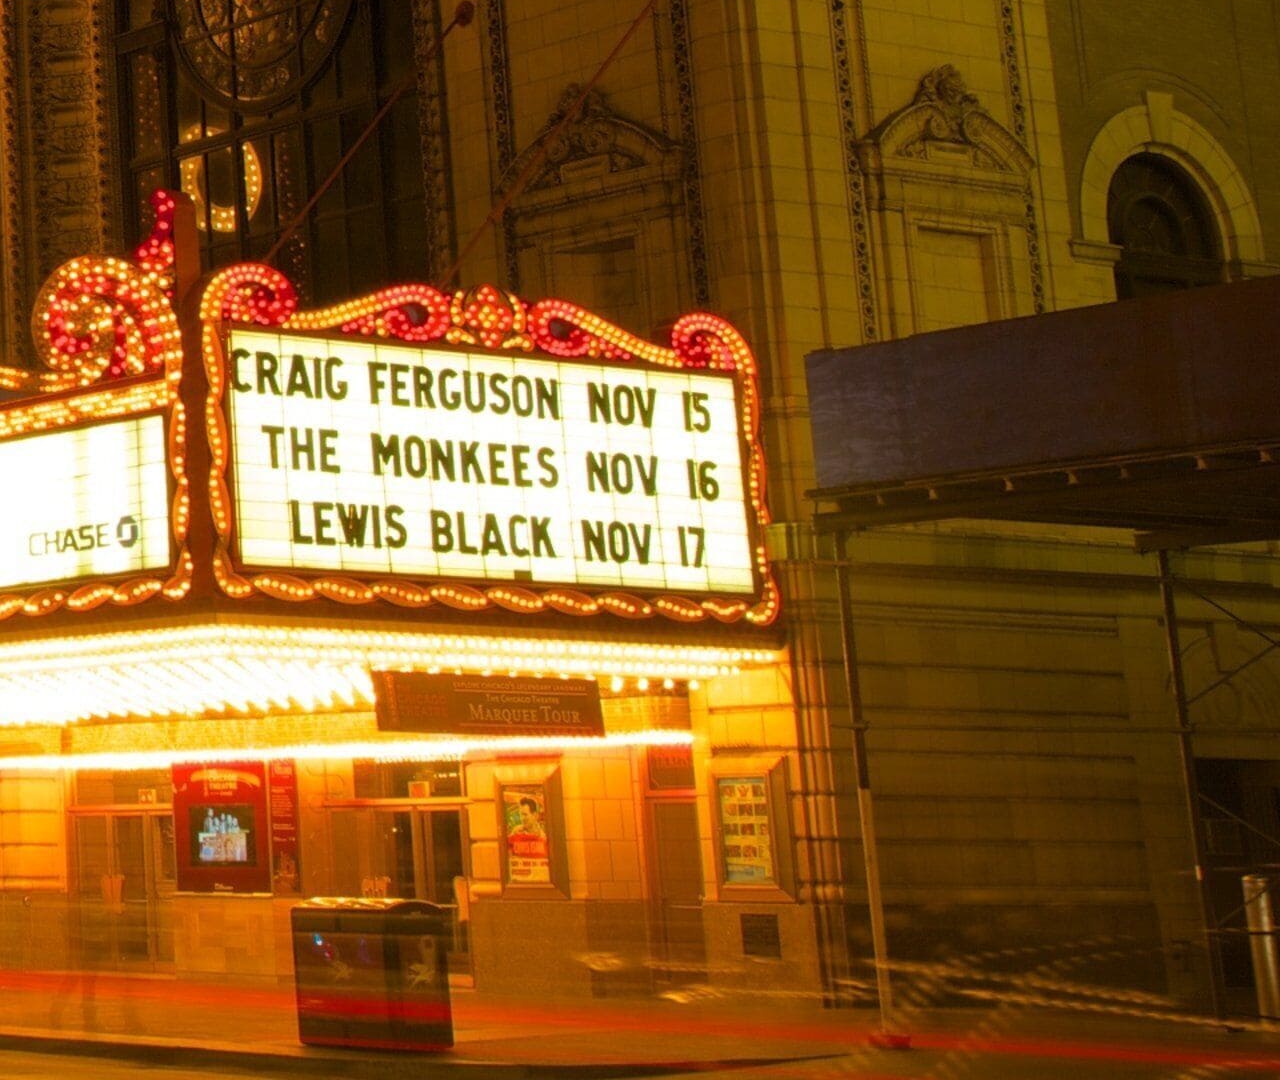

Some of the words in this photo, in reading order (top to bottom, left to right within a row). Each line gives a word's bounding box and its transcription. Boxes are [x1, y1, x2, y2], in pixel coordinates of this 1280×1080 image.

[232, 348, 348, 400] CRAIG
[368, 361, 560, 421] FERGUSON
[588, 382, 656, 429] NOV
[682, 391, 711, 433] 15
[261, 425, 340, 474] THE
[372, 433, 559, 488] MONKEES
[586, 450, 657, 497] NOV
[688, 459, 720, 501] 16
[28, 523, 112, 557] CHASE
[290, 500, 408, 549] LEWIS
[431, 510, 557, 558] BLACK
[581, 518, 652, 567] NOV
[678, 526, 705, 568] 17
[468, 703, 538, 724] MARQUEE
[540, 706, 583, 723] TOUR
